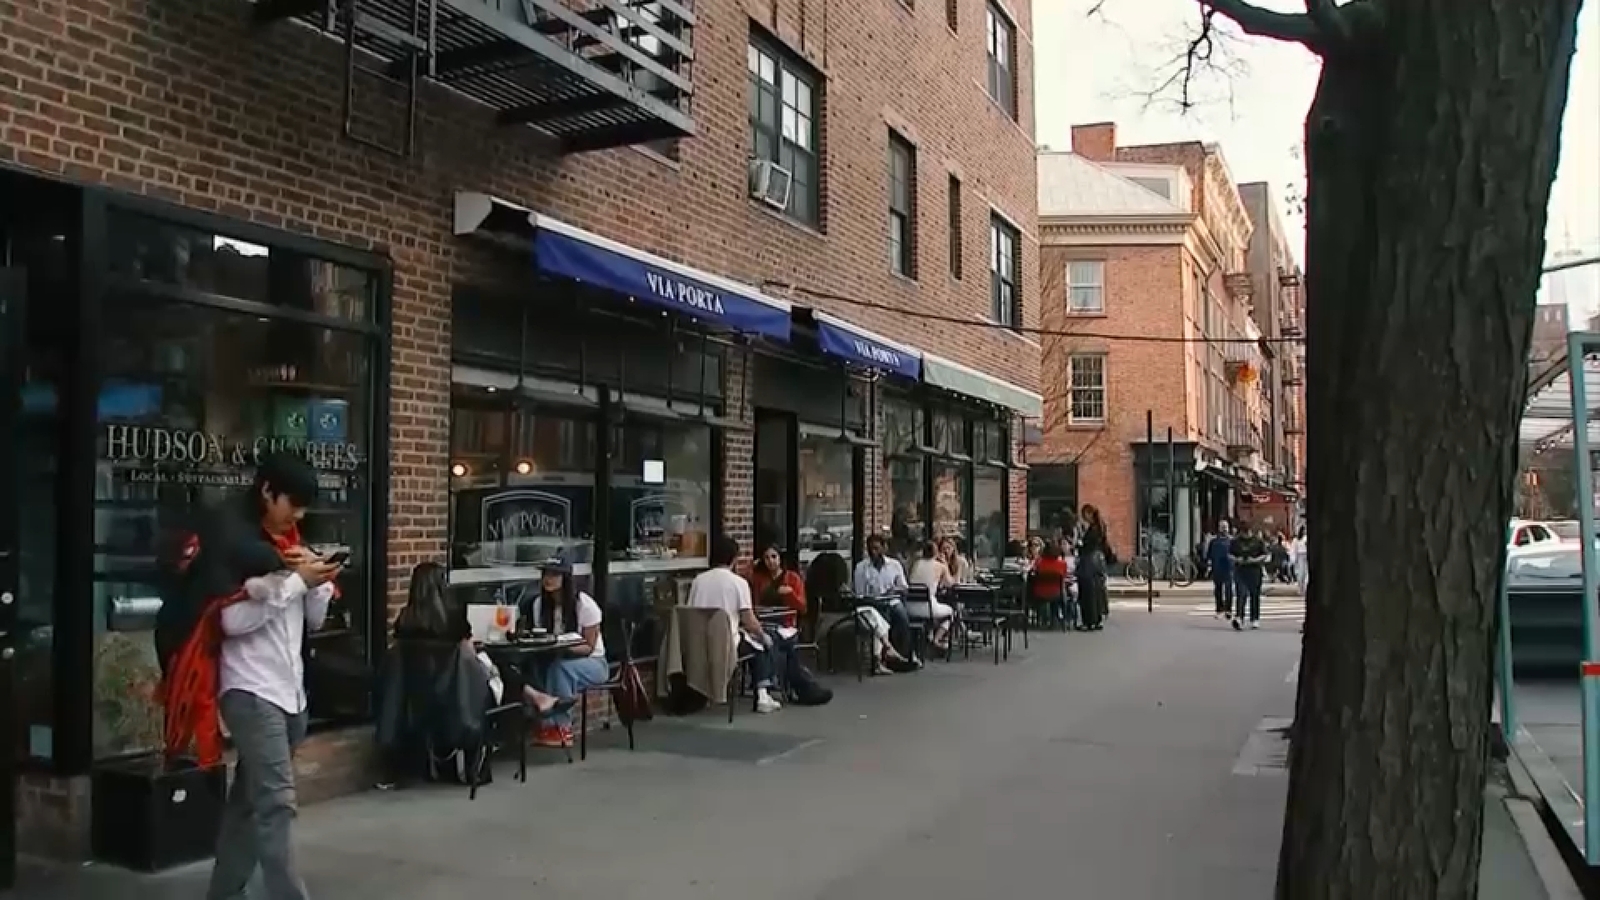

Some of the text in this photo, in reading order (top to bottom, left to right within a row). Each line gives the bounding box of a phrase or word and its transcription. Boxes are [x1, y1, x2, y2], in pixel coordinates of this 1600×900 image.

[646, 272, 724, 316] VIA PORTA
[106, 424, 226, 464] HUDSON
[232, 441, 247, 466] &
[520, 510, 565, 540] PORTA
